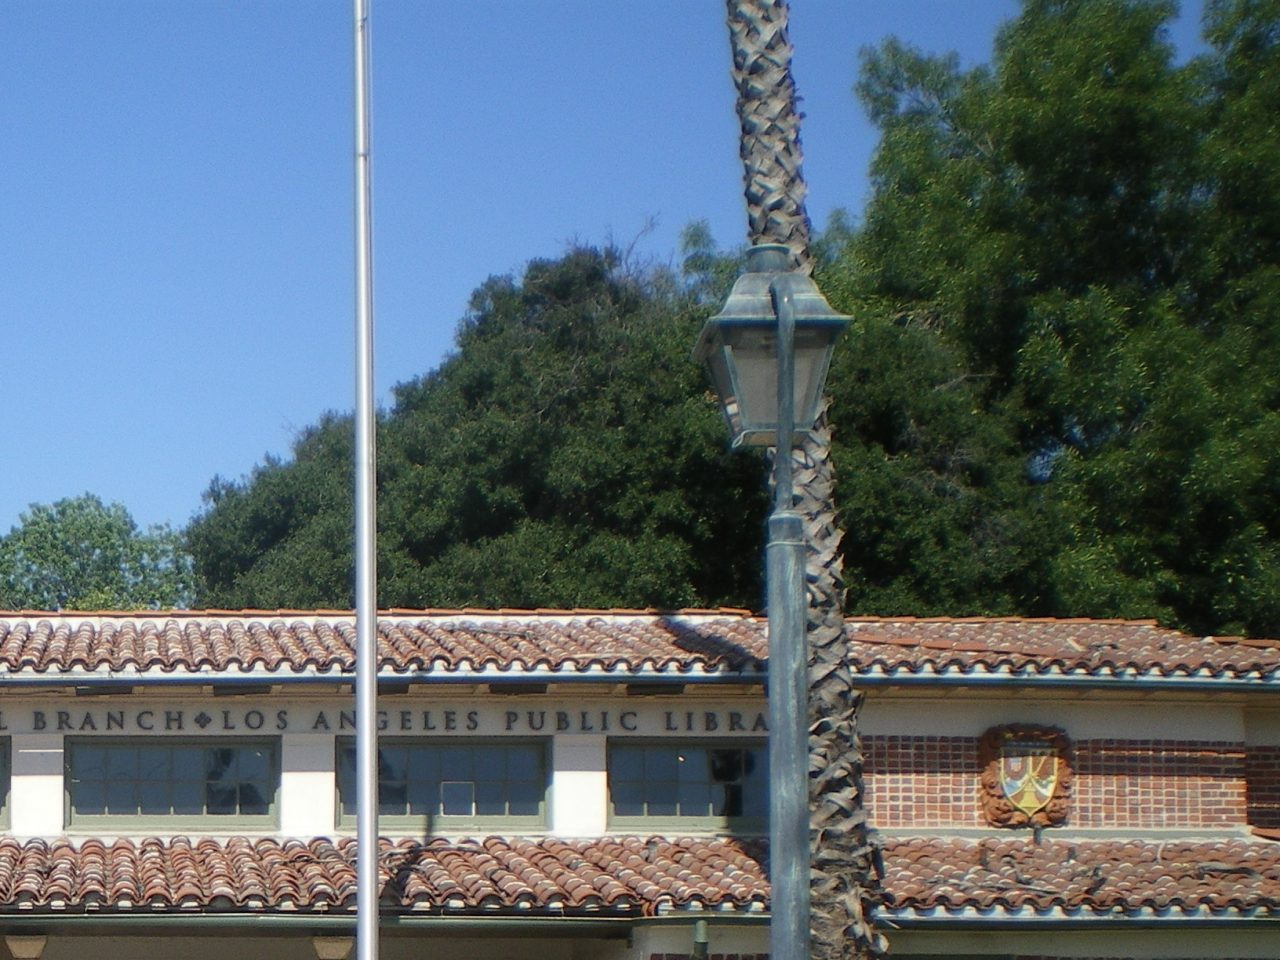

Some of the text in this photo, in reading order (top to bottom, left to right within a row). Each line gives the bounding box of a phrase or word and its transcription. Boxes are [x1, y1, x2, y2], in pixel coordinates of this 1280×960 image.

[32, 710, 185, 731] BRANCH
[222, 709, 289, 730] LOS
[311, 710, 480, 731] ANGELES
[504, 710, 639, 731] PUBLIC
[664, 711, 770, 732] LIBRA
